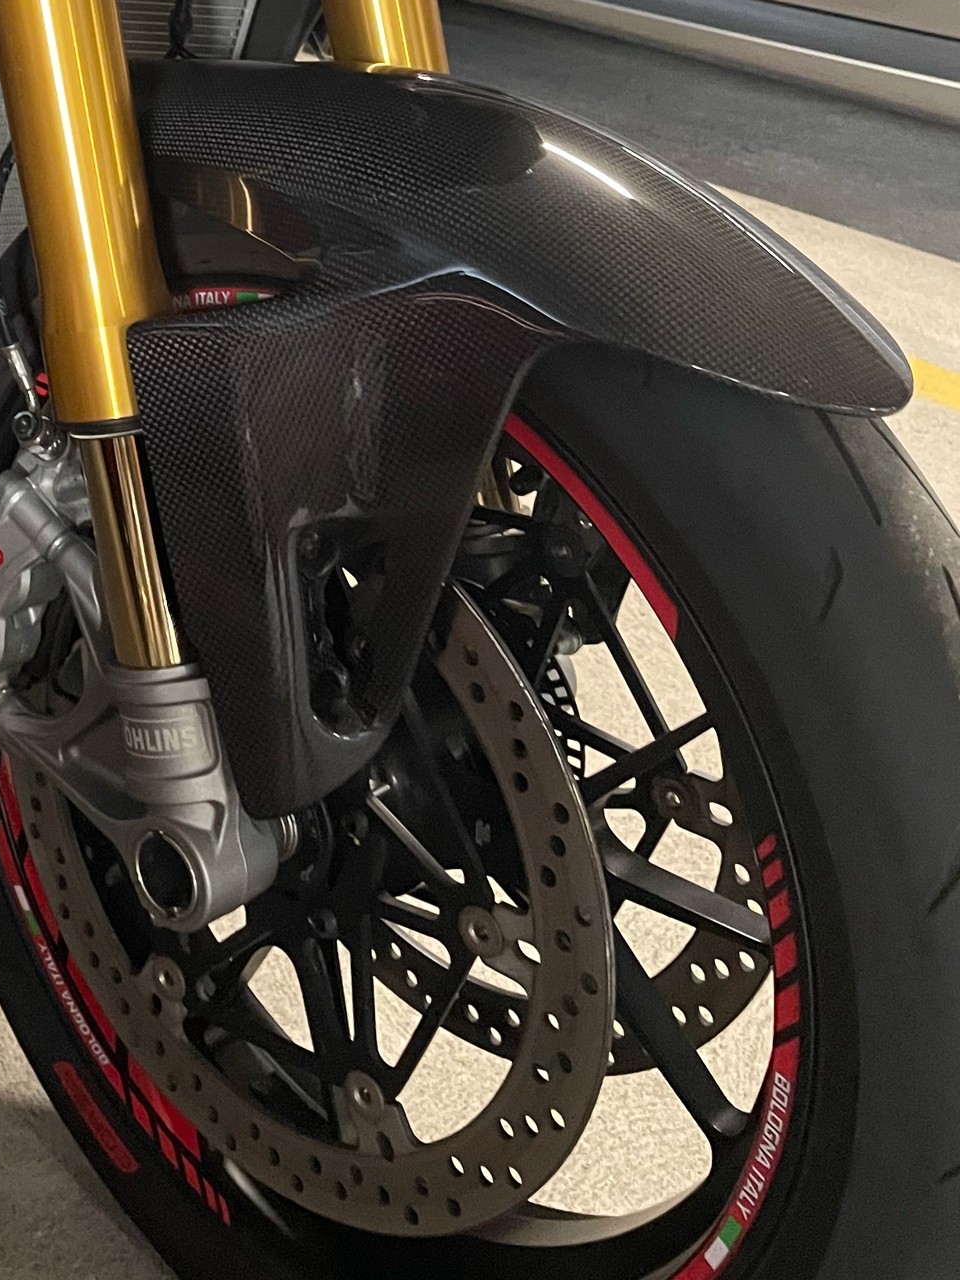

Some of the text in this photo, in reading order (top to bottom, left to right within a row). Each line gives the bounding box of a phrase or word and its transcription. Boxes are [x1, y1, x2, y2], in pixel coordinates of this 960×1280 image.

[194, 290, 231, 306] ITALY
[38, 942, 65, 986] ITALY
[62, 990, 110, 1065] BOLOGNA
[736, 1071, 791, 1221] BOLOGNA ITALY
